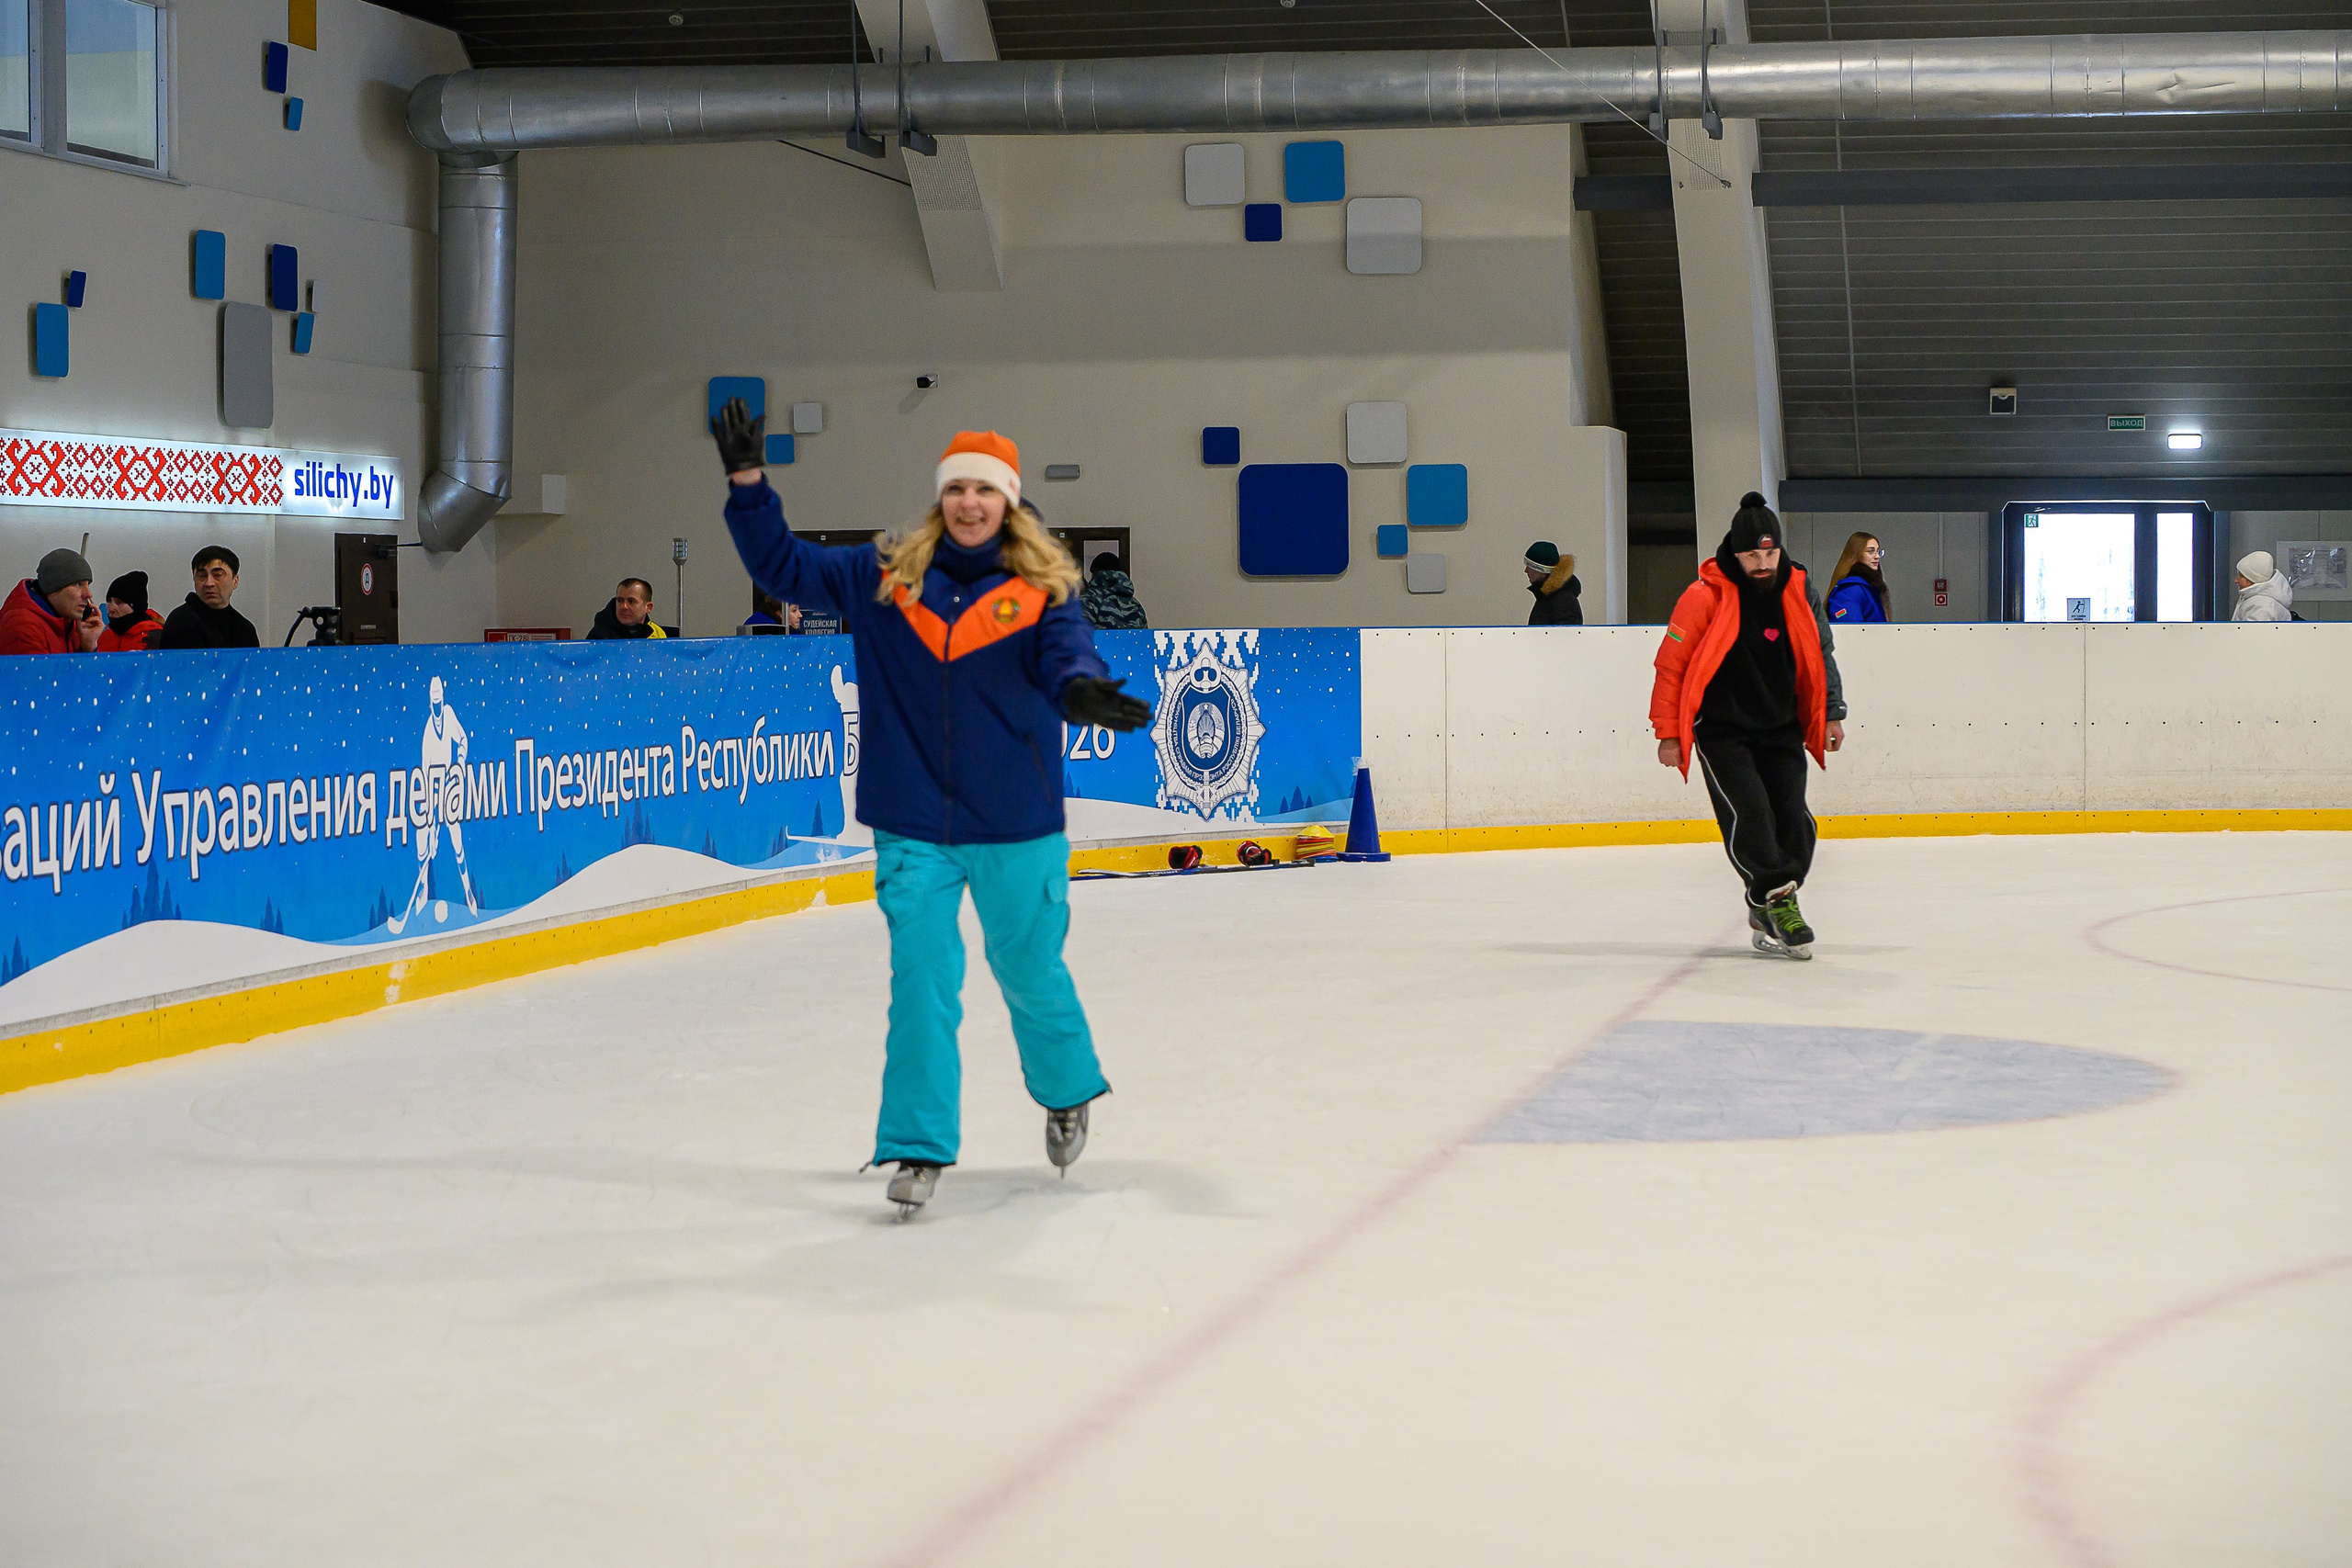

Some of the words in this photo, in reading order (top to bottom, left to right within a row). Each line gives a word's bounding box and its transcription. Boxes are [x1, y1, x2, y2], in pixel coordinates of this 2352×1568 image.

[2110, 419, 2143, 427] ВЫХОД
[294, 460, 394, 509] silichy.by
[803, 618, 837, 627] СУДЕЙСКАЯ
[0, 773, 122, 896] аций
[130, 768, 377, 882] Управления
[385, 759, 508, 849] делами
[514, 738, 676, 833] Президента
[681, 715, 835, 807] Республики
